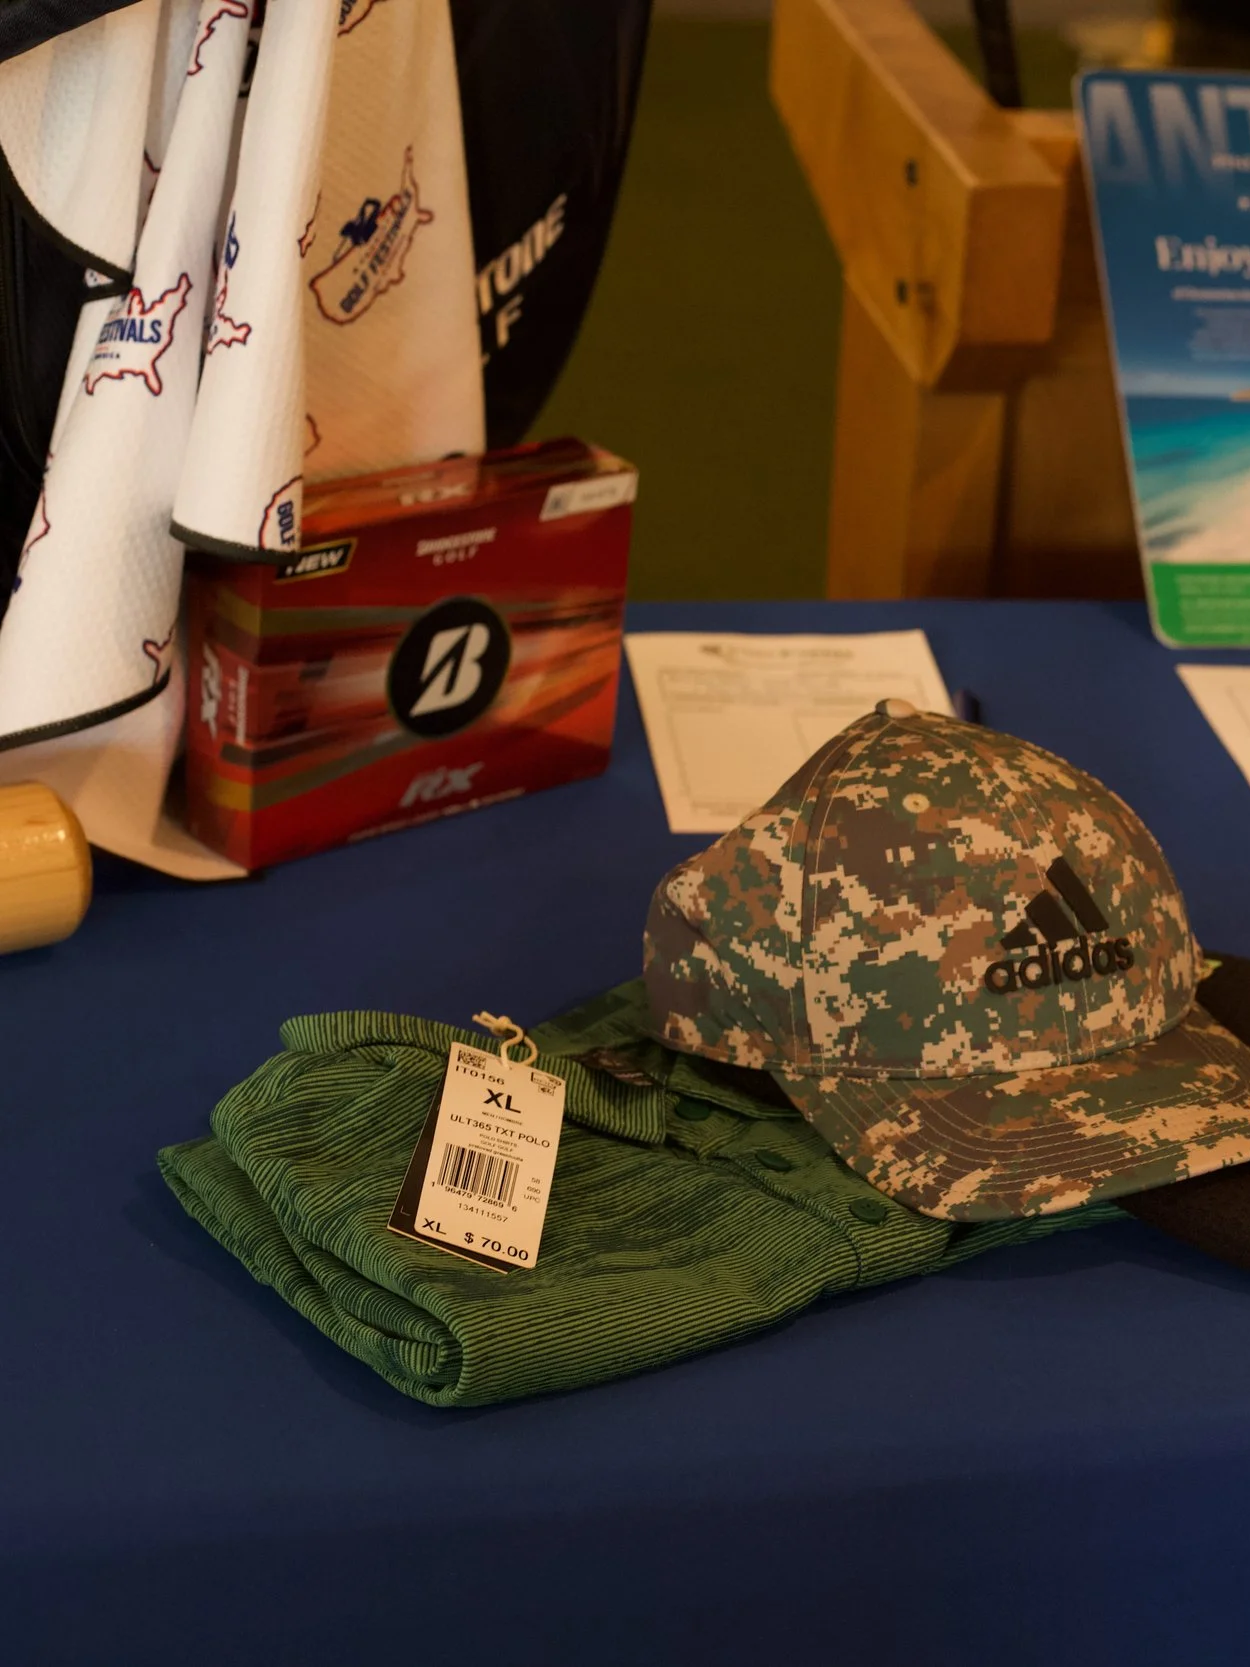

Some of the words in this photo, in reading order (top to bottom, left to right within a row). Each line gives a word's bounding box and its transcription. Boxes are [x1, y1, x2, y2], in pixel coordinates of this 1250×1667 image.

[277, 501, 297, 547] GOLF
[984, 934, 1135, 995] adidas
[483, 1088, 522, 1114] XL
[450, 1113, 492, 1132] ULT365
[494, 1125, 516, 1139] TXT
[518, 1132, 550, 1149] POLO
[444, 1184, 473, 1200] 96479
[476, 1194, 505, 1210] 72869
[511, 1204, 518, 1213] 6
[523, 1193, 542, 1205] UPC
[422, 1217, 447, 1236] XL
[463, 1231, 475, 1245] $
[480, 1236, 530, 1262] 70.00
